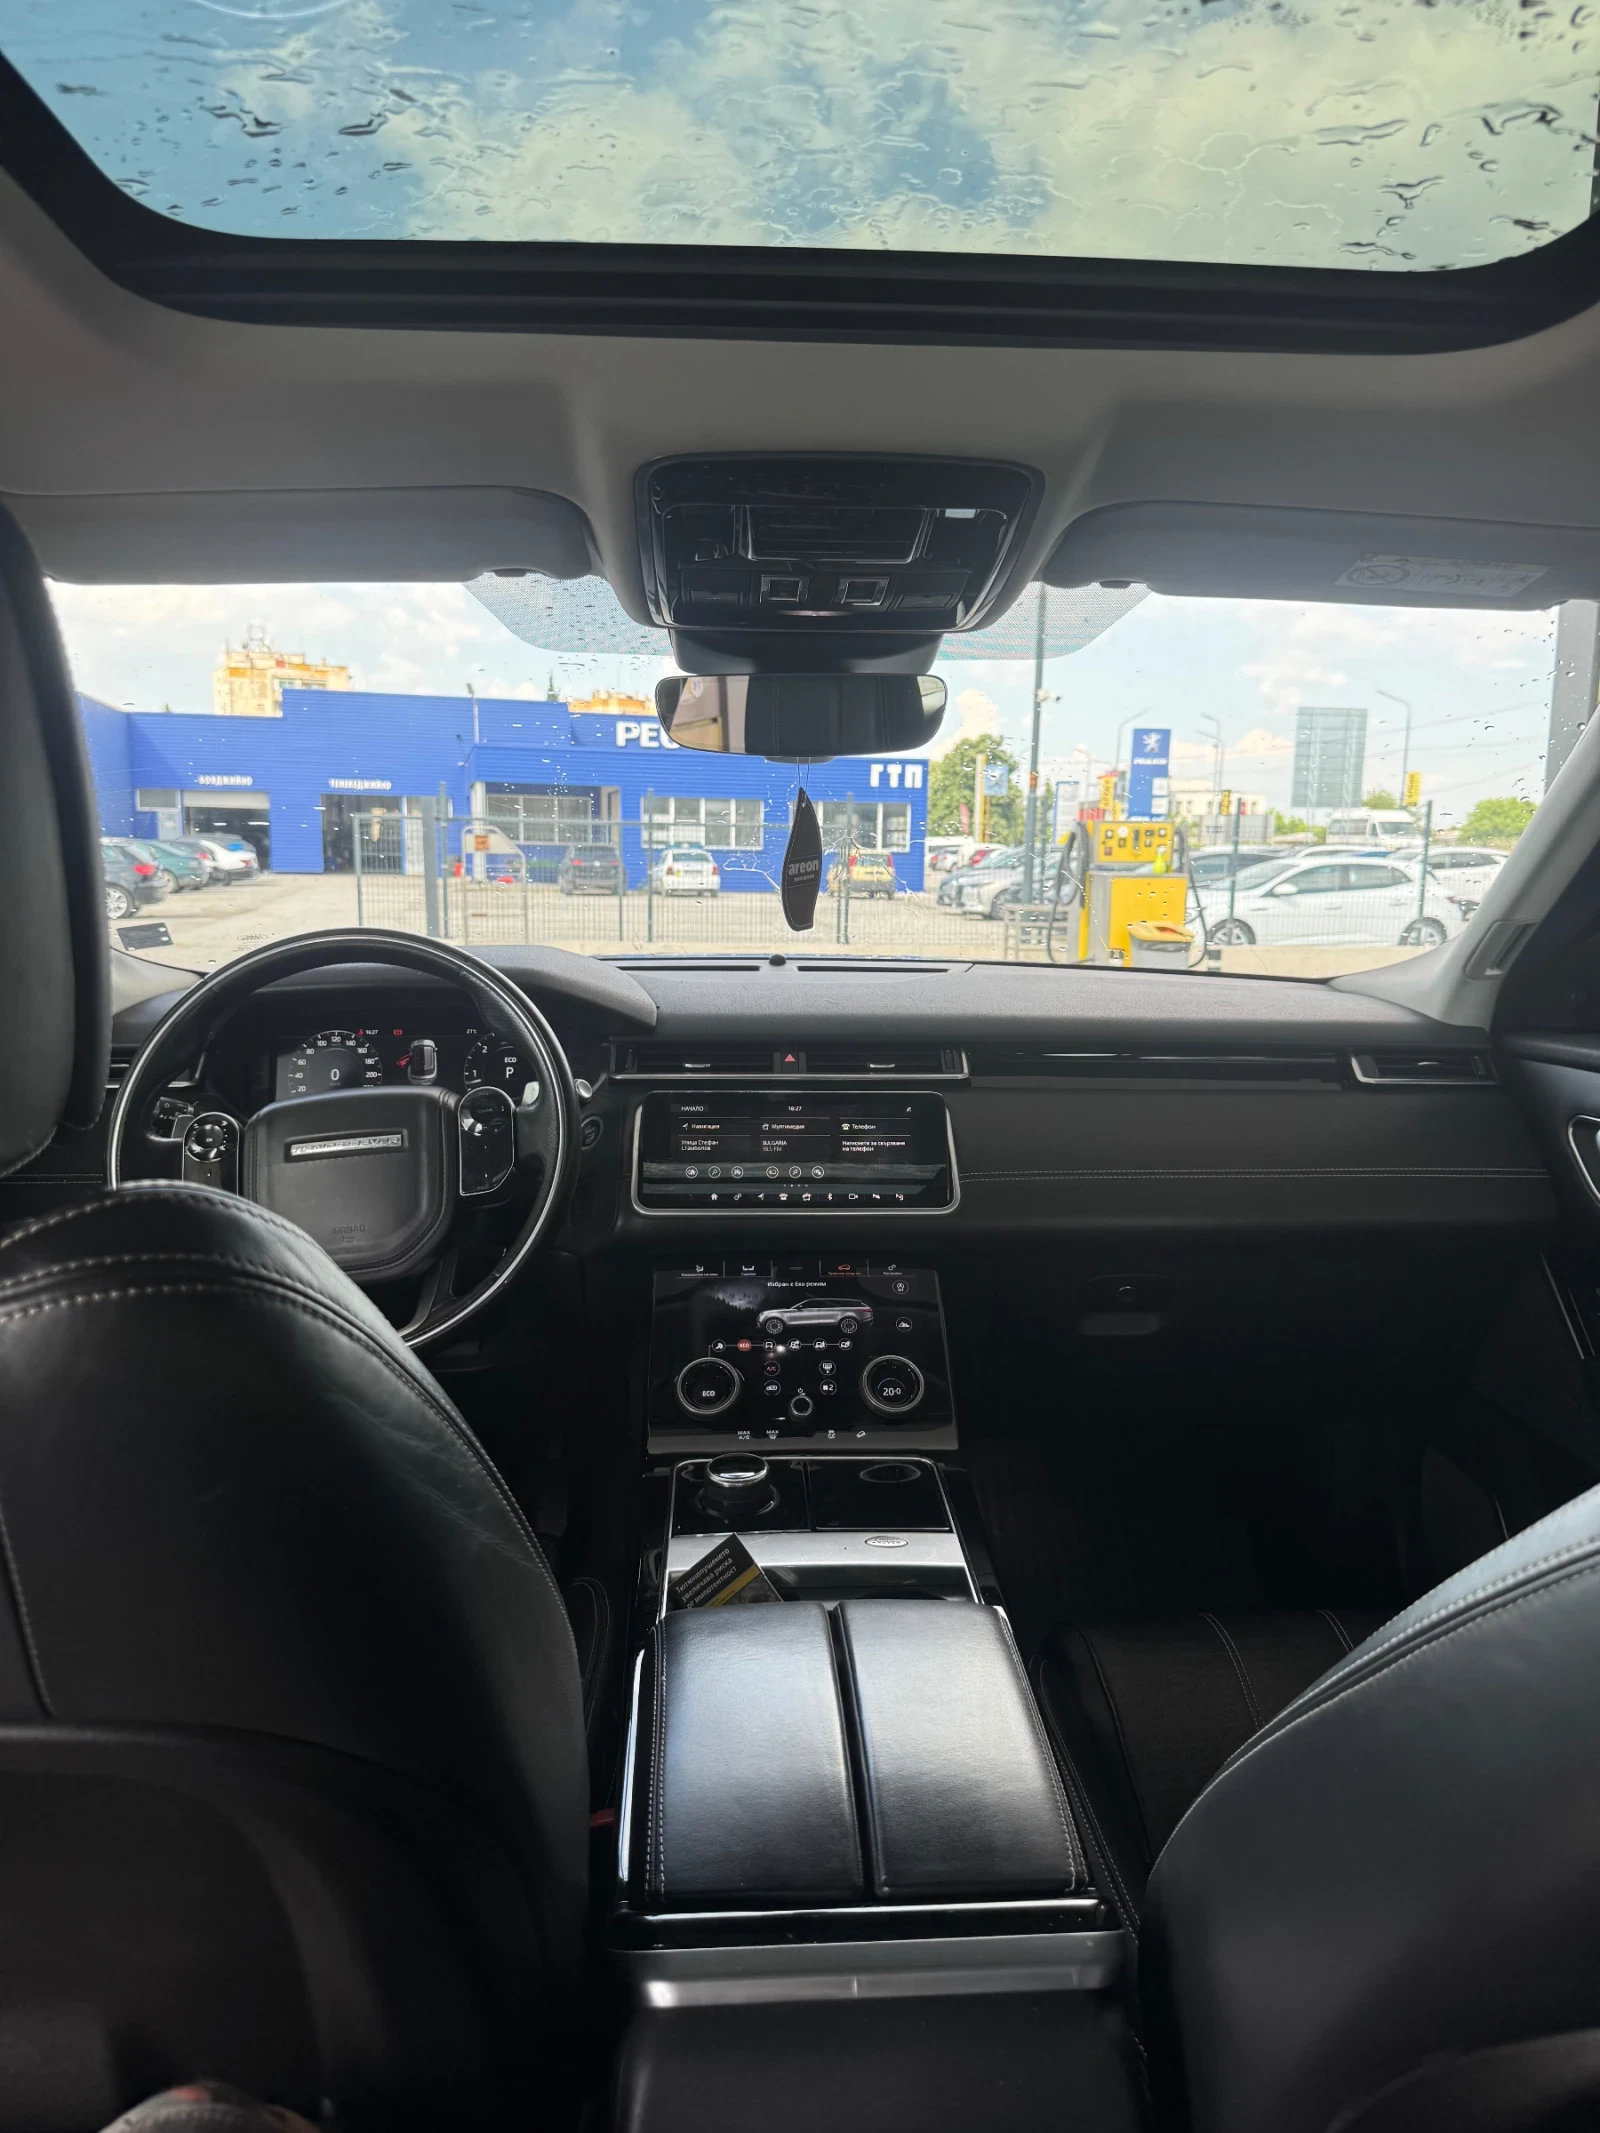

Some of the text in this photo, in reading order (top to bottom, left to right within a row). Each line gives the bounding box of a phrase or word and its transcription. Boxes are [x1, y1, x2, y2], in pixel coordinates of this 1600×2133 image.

[870, 764, 923, 788] ГТП
[789, 860, 819, 875] areon
[331, 1068, 340, 1081] 0
[506, 1067, 514, 1078] P
[332, 1224, 366, 1235] AIRBAG
[675, 1548, 730, 1594] Тютюнопушенето
[681, 1574, 715, 1603] увеличава
[713, 1557, 733, 1577] риска
[695, 1566, 737, 1604] импотентност
